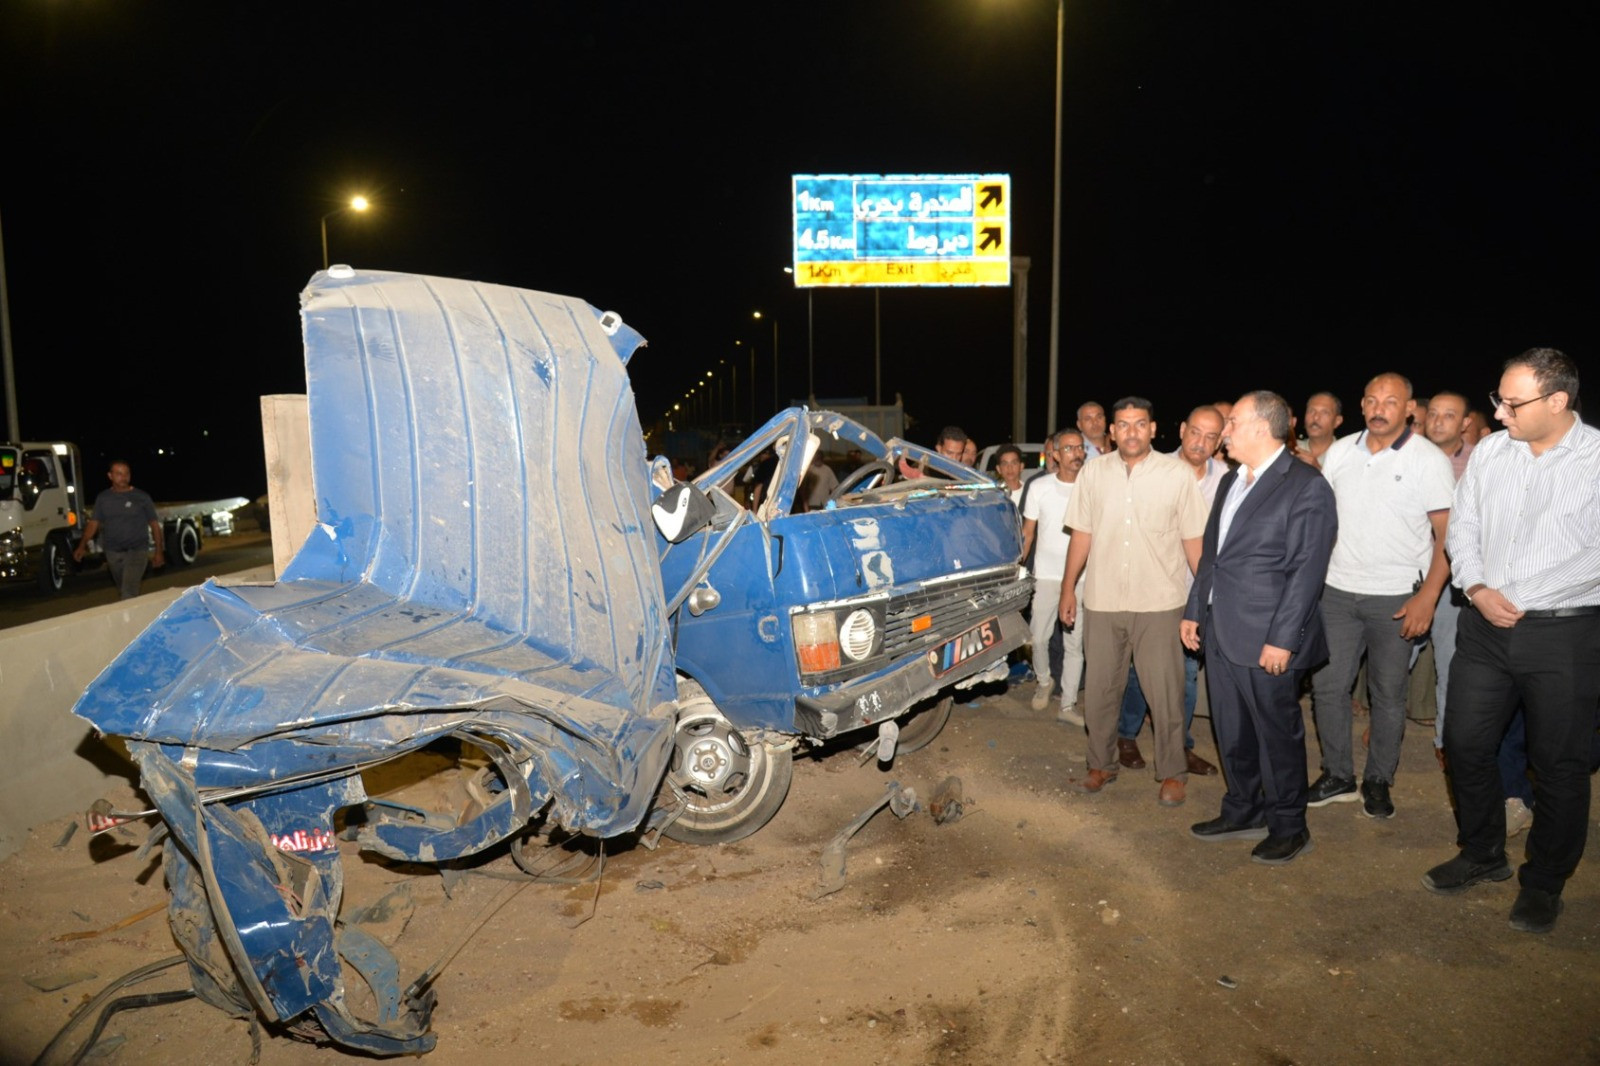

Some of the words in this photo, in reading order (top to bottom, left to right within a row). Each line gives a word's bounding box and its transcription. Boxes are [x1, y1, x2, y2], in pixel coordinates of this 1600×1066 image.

[856, 196, 904, 218] بحري
[906, 225, 970, 254] ديروط
[886, 263, 914, 275] Exit
